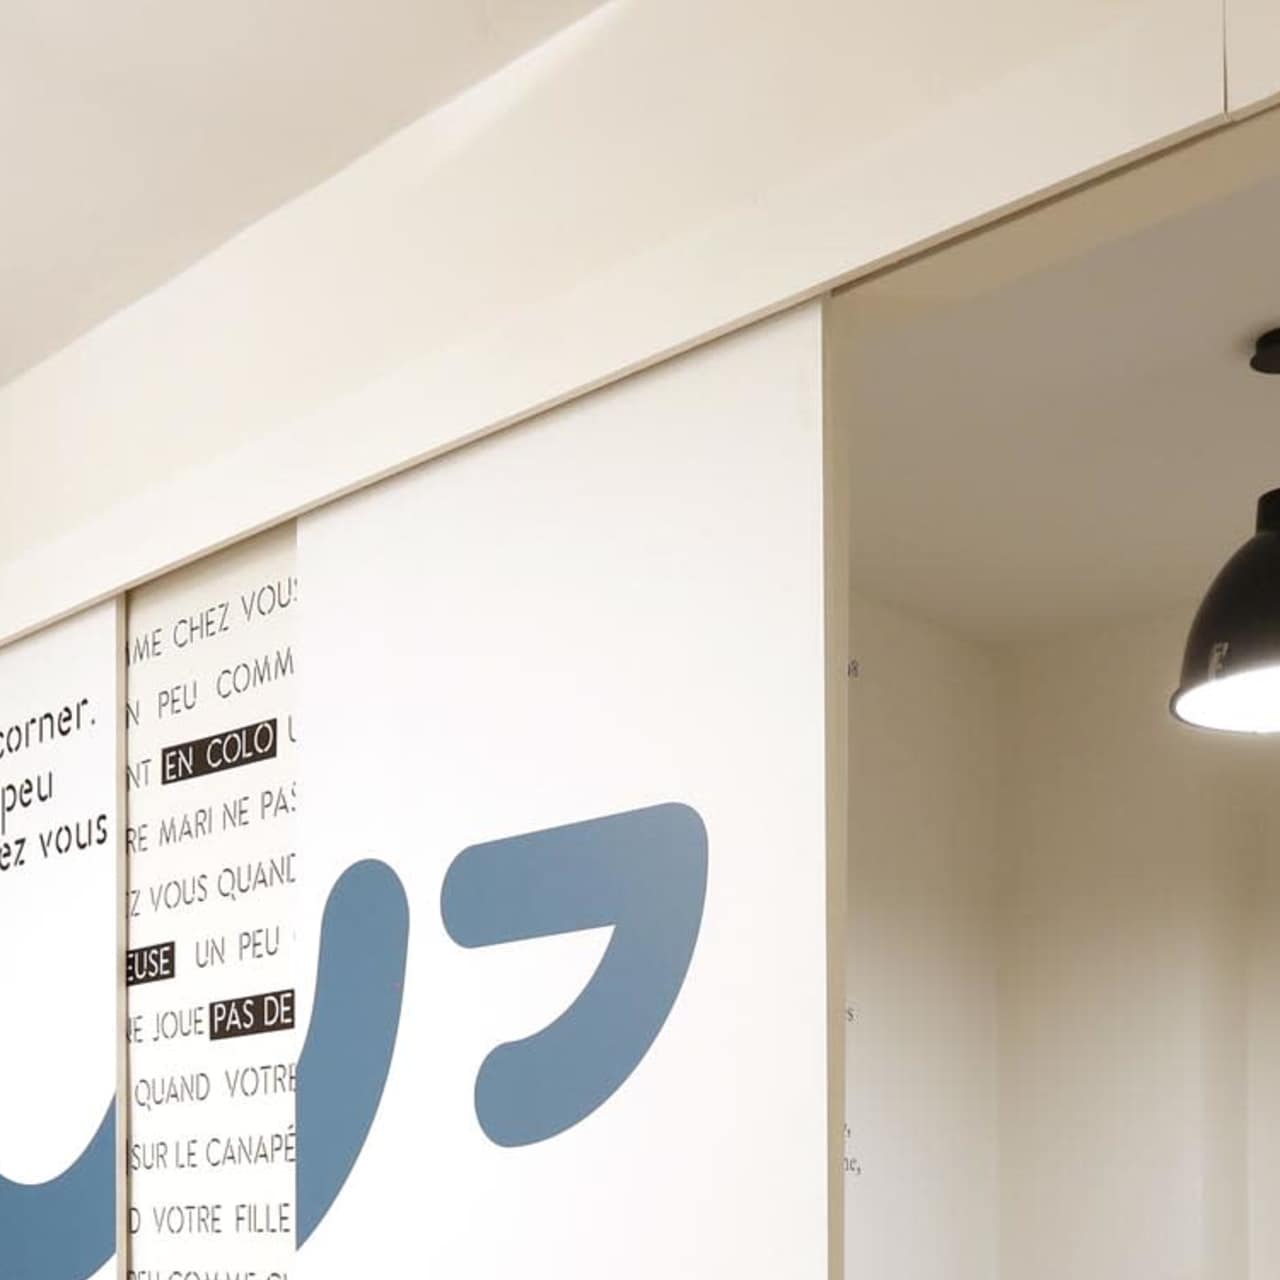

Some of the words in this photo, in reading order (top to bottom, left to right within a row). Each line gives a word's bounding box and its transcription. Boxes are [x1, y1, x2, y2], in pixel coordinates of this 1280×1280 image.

[173, 601, 230, 648] CHEZ
[158, 680, 197, 719] PEU
[216, 647, 295, 699] COMM
[165, 745, 193, 781] EN
[206, 721, 274, 768] COLO
[1, 771, 53, 836] peu
[158, 806, 213, 848] MARI
[222, 796, 250, 831] NE
[39, 813, 109, 859] vous
[150, 873, 208, 912] VOUS
[195, 936, 225, 968] UN
[238, 925, 280, 961] PEU
[152, 1006, 206, 1042] JOUE
[213, 998, 255, 1033] PAS
[263, 992, 293, 1026] DE
[134, 1072, 211, 1111] QUAND
[129, 1141, 168, 1171] SUR
[175, 1139, 198, 1169] LE
[205, 1123, 297, 1167] CANAPÉ
[129, 1207, 141, 1235] D
[153, 1204, 223, 1235] VOTRE
[235, 1203, 291, 1234] FILLE
